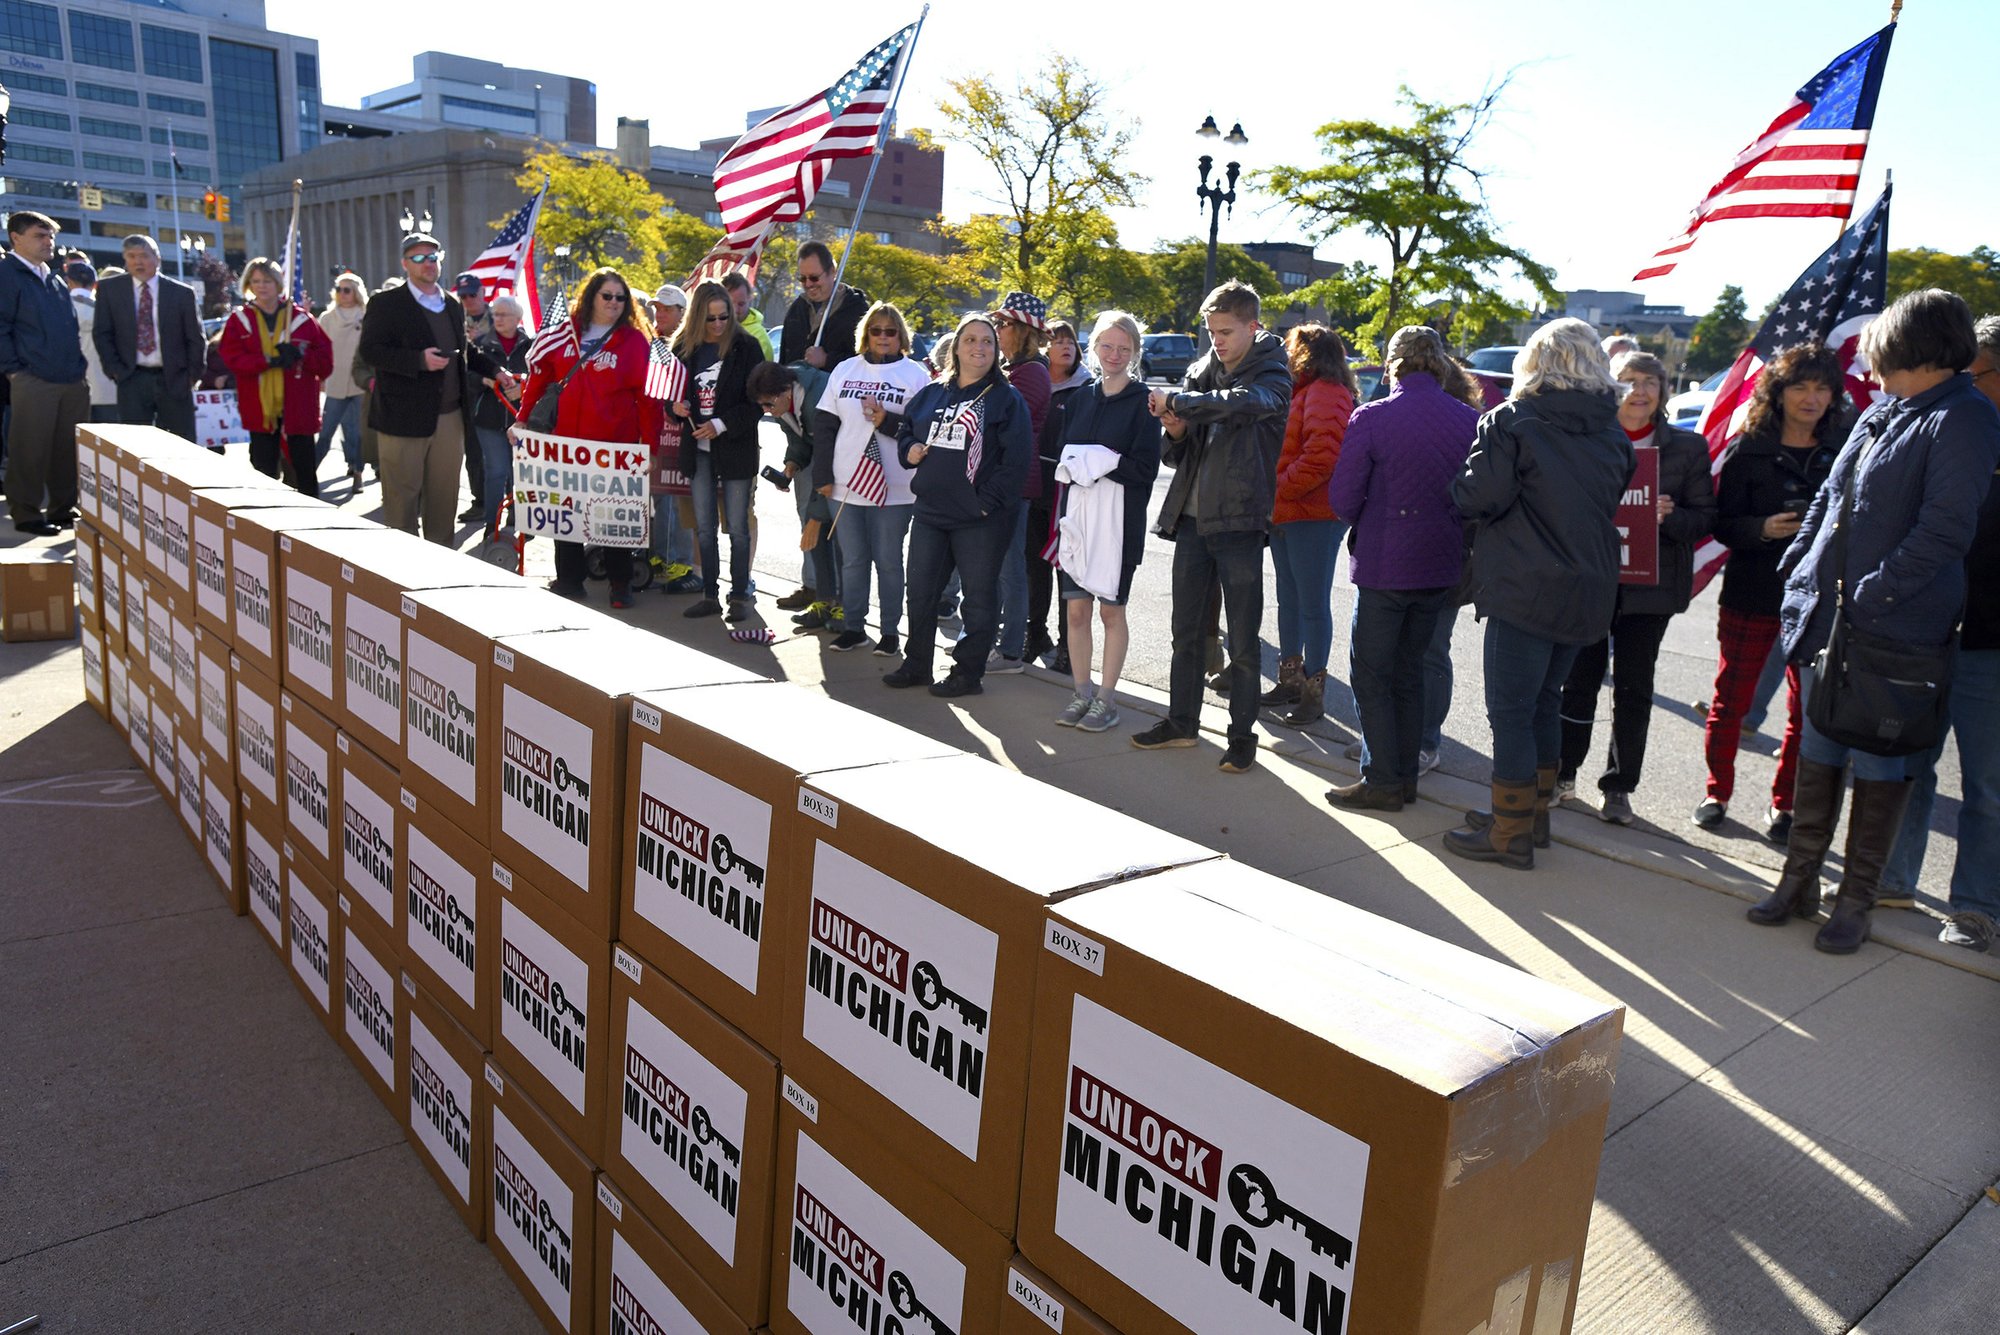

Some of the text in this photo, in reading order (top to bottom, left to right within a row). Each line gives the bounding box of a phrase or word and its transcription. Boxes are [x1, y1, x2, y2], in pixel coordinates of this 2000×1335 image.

[846, 381, 878, 390] UNLOCK
[526, 438, 631, 471] UNLOCK
[515, 491, 583, 514] REPEAL
[519, 463, 643, 497] MICHIGAN
[527, 506, 574, 536] 1945
[594, 506, 640, 522] SIGN
[594, 524, 642, 538] HERE
[197, 561, 226, 598] MICHIGAN
[236, 589, 270, 631] MICHIGAN
[288, 601, 312, 629] UNLOCK
[288, 621, 332, 669] MICHIGAN
[347, 630, 375, 663] UNLOCK
[496, 651, 507, 664] BOX
[346, 654, 400, 710] MICHIGAN
[410, 670, 444, 709] UNLOCK
[408, 697, 475, 767] MICHIGAN
[636, 708, 652, 724] BOX
[239, 728, 276, 778] MICHIGAN
[506, 731, 549, 778] UNLOCK
[288, 774, 328, 830] MICHIGAN
[346, 805, 371, 841] UNLOCK
[503, 761, 588, 847] MICHIGAN
[803, 795, 825, 815] BOX
[644, 797, 705, 857] UNLOCK
[345, 827, 393, 894] MICHIGAN
[495, 867, 505, 882] BOX
[250, 867, 281, 922] MICHIGAN
[410, 863, 444, 909] UNLOCK
[637, 831, 762, 943] MICHIGAN
[291, 920, 328, 984] MICHIGAN
[409, 888, 475, 973] MICHIGAN
[818, 904, 902, 985] UNLOCK
[1052, 929, 1081, 957] BOX
[347, 961, 371, 1005] UNLOCK
[506, 943, 548, 996] UNLOCK
[618, 954, 631, 972] BOX
[346, 982, 393, 1060] MICHIGAN
[503, 970, 585, 1073] MICHIGAN
[808, 944, 984, 1099] MICHIGAN
[412, 1051, 443, 1100] UNLOCK
[630, 1051, 688, 1121] UNLOCK
[787, 1084, 805, 1107] BOX
[411, 1073, 470, 1169] MICHIGAN
[1078, 1076, 1210, 1189] UNLOCK
[624, 1080, 738, 1218] MICHIGAN
[497, 1149, 536, 1212] UNLOCK
[600, 1187, 613, 1207] BOX
[495, 1174, 571, 1294] MICHIGAN
[802, 1193, 878, 1286] UNLOCK
[1064, 1121, 1347, 1335] MICHIGAN
[1015, 1280, 1042, 1311] BOX
